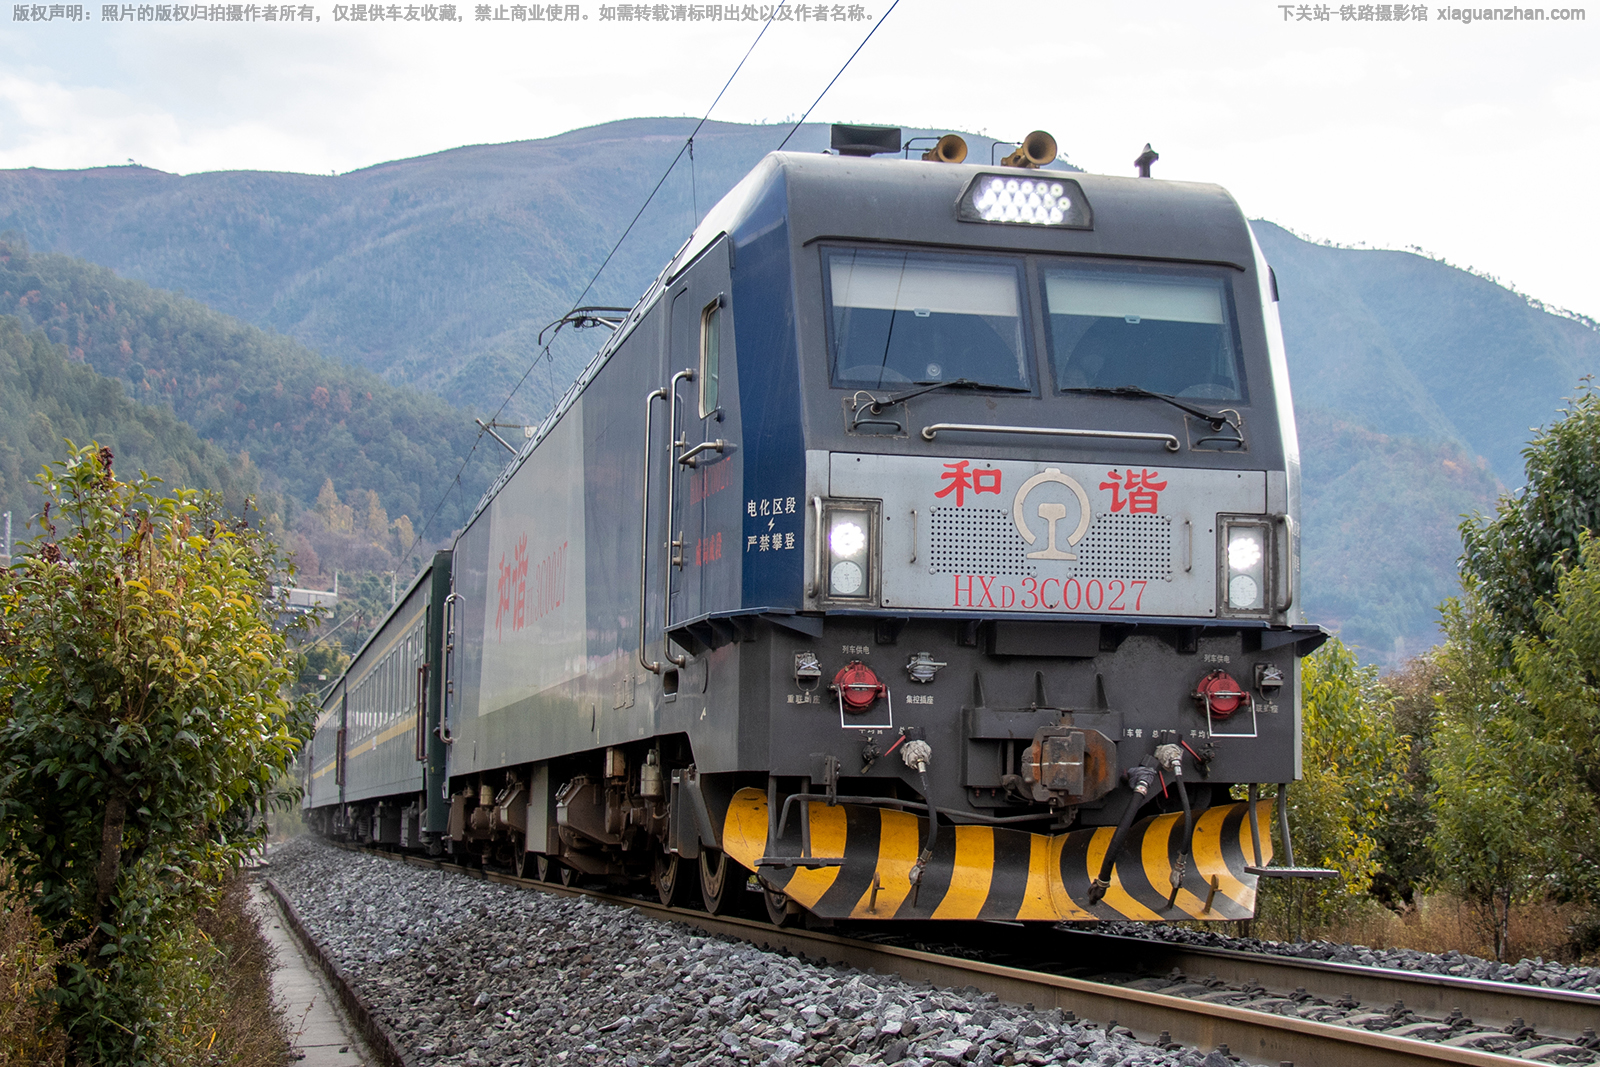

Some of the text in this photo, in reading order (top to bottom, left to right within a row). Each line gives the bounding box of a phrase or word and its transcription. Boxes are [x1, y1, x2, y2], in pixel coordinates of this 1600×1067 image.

[747, 496, 796, 517] 电化区段
[746, 532, 796, 553] 严禁攀登
[952, 573, 1149, 612] HXD3C0027
[842, 645, 870, 655] 列车供电
[1204, 654, 1231, 664] 列车供电
[905, 695, 934, 705] 集控插座
[1123, 728, 1143, 739] 车管
